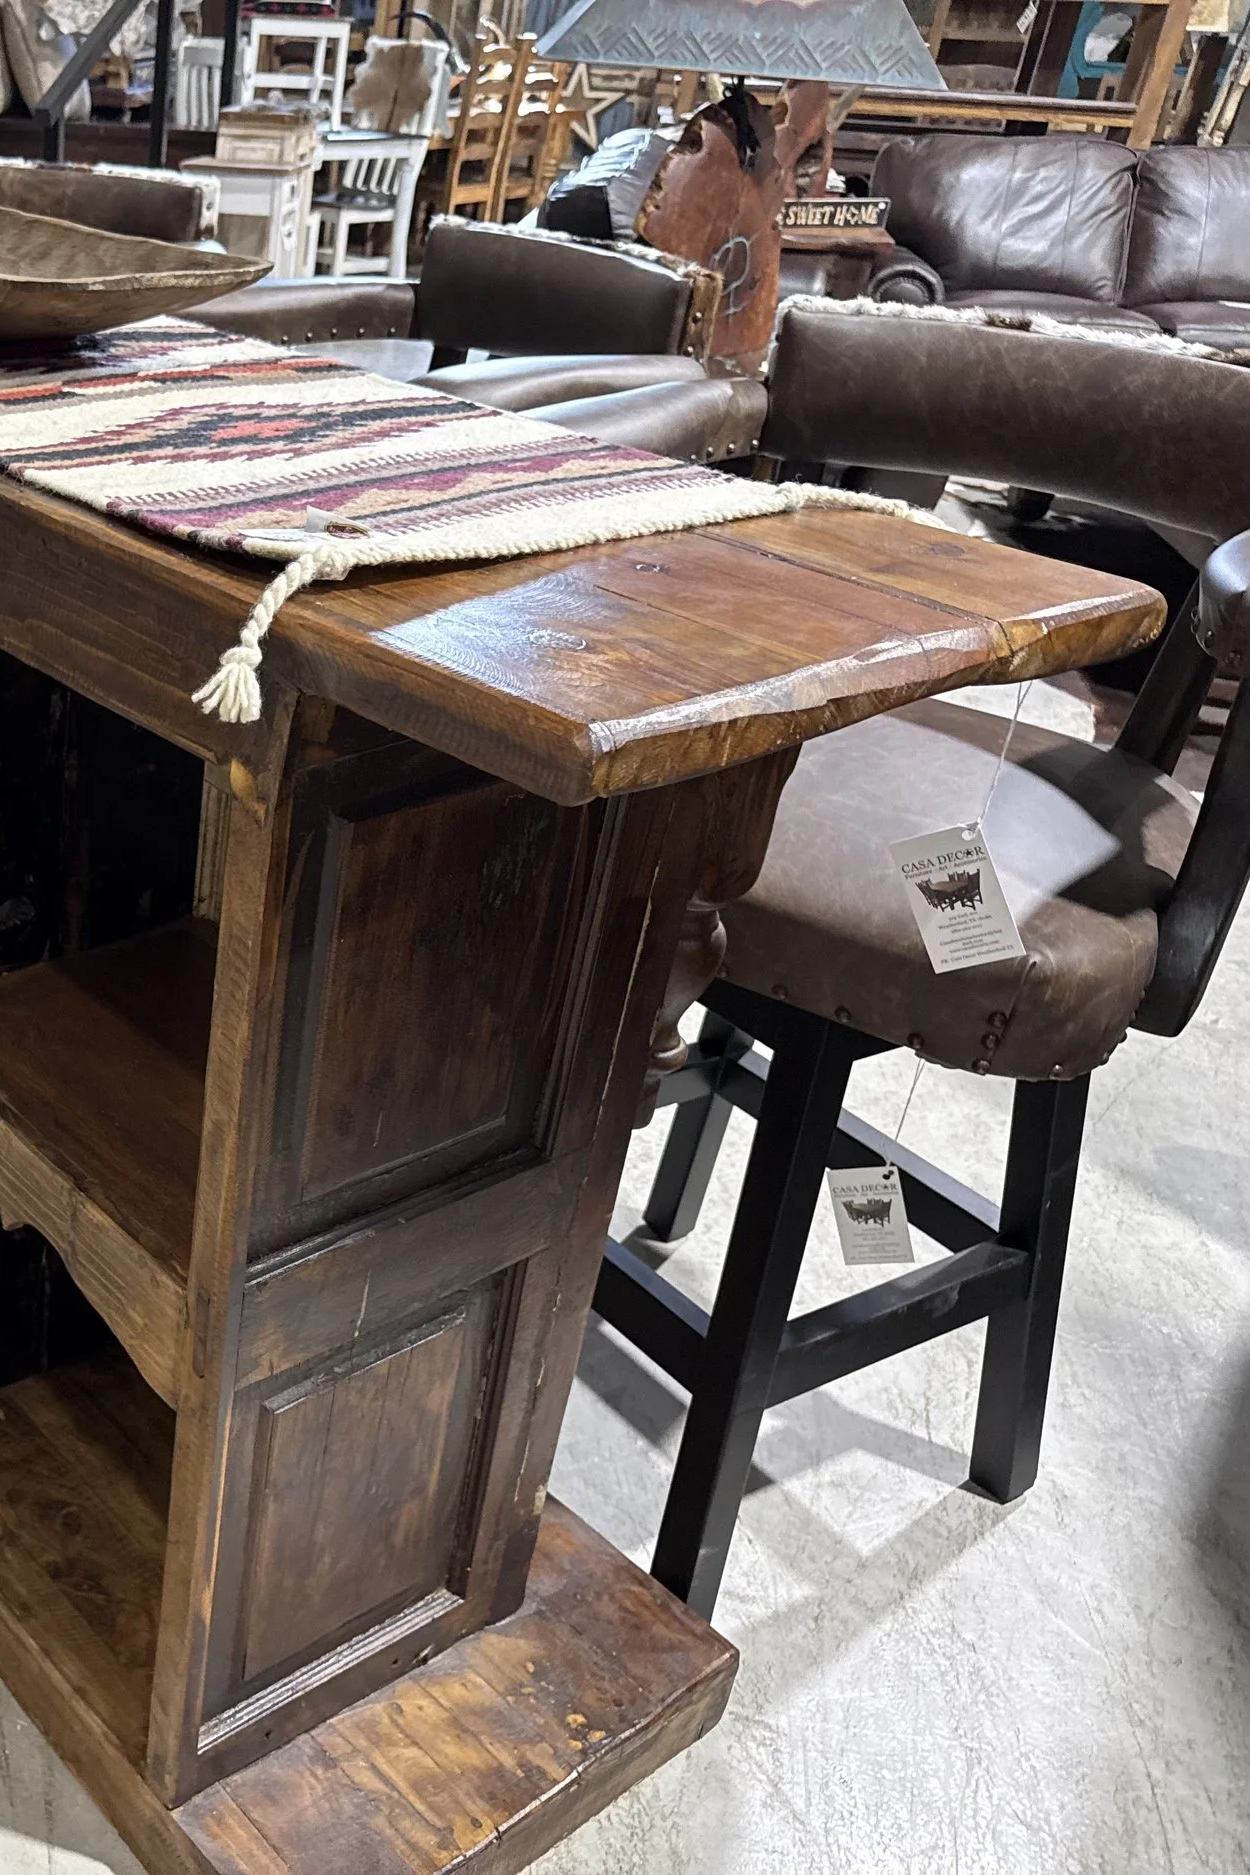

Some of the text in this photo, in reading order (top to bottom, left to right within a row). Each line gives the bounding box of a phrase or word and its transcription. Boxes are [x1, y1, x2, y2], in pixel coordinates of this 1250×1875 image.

[786, 205, 834, 226] SWEET
[901, 846, 985, 874] CASA DECOR
[832, 1185, 859, 1194] CASA
